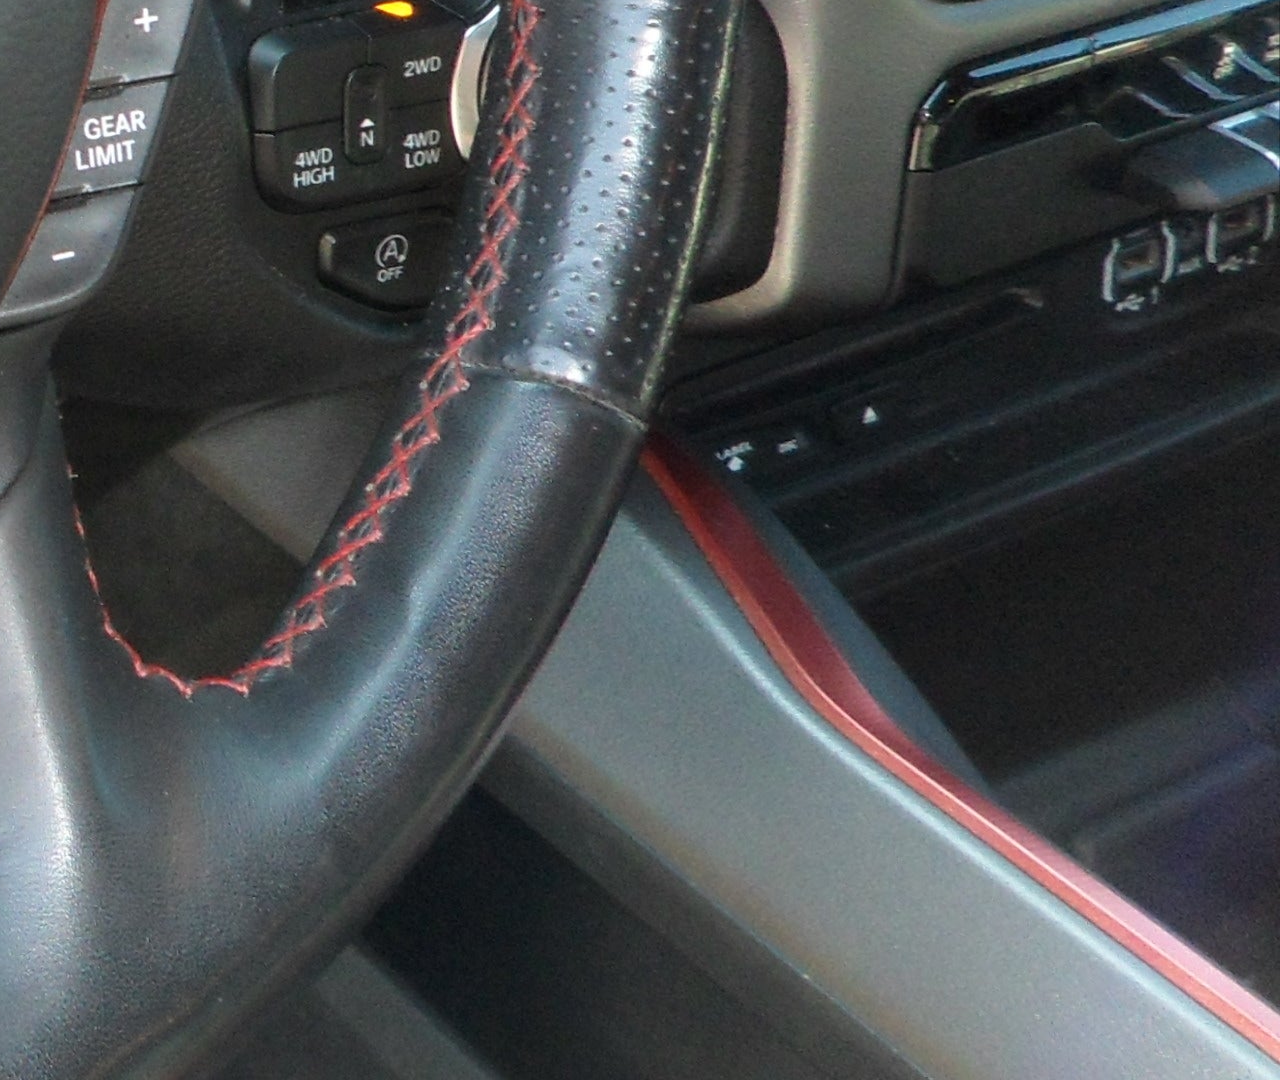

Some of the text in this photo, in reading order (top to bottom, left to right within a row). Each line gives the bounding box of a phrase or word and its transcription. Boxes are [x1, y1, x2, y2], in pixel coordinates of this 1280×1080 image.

[403, 55, 442, 78] 2WD
[83, 110, 147, 142] GEAR
[360, 128, 375, 148] N
[402, 128, 441, 150] 4WD
[74, 139, 136, 172] LIMIT
[294, 146, 334, 169] 4WD
[404, 149, 441, 170] LOW
[293, 166, 336, 190] HIGH
[376, 266, 404, 283] OFF
